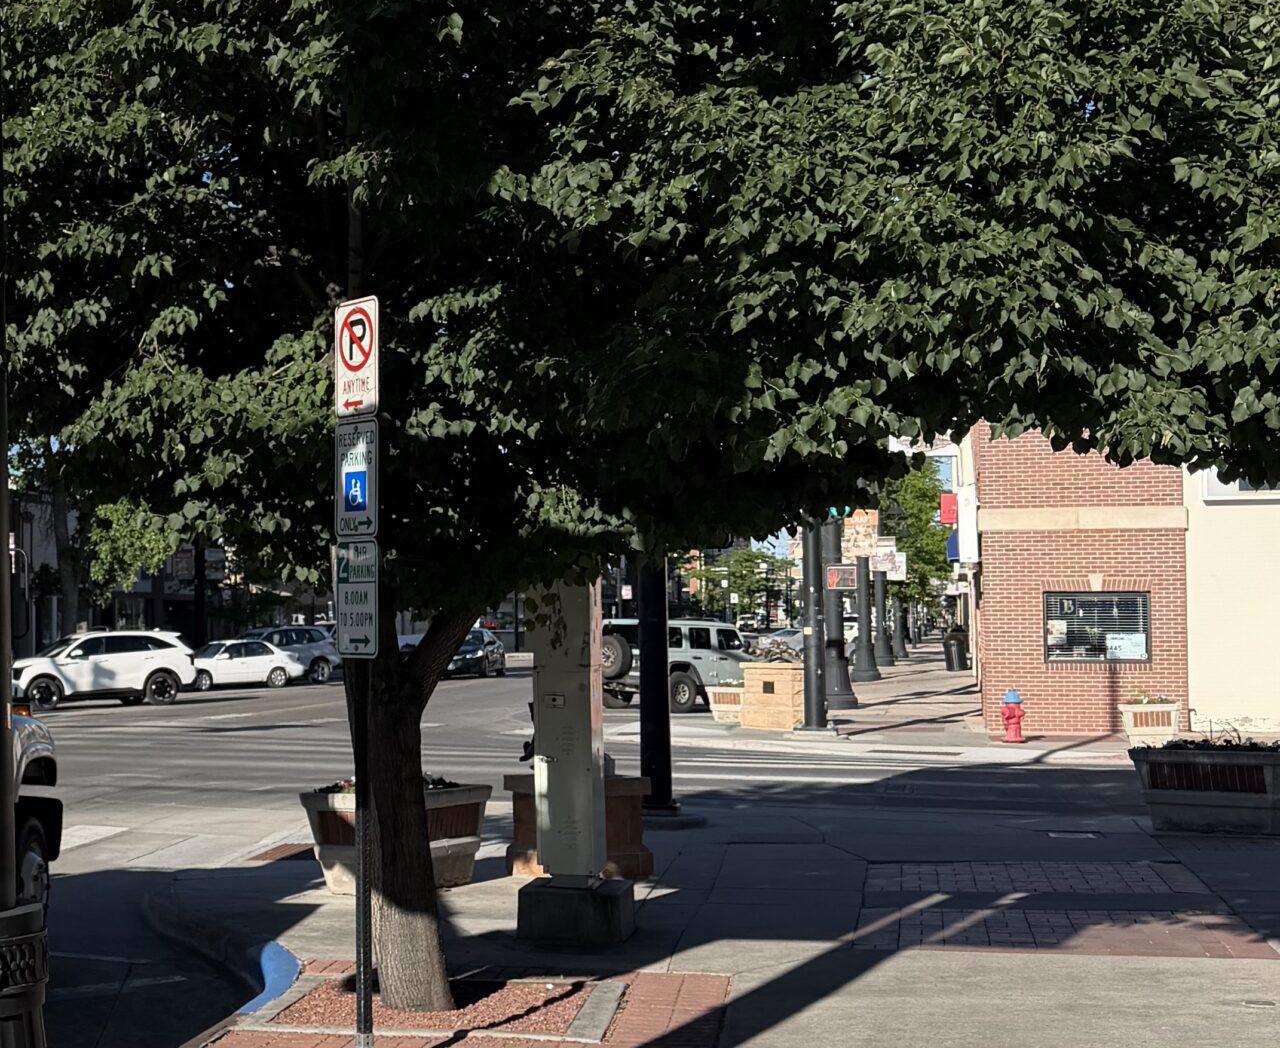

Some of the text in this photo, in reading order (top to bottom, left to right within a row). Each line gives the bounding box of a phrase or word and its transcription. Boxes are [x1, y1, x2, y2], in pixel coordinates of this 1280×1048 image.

[342, 376, 370, 394] ANYTIME
[339, 430, 375, 448] RESERVED
[341, 450, 372, 467] PARKING
[340, 517, 357, 532] ONLY
[338, 549, 348, 578] 2
[349, 564, 375, 580] PARKING
[340, 612, 348, 626] TO
